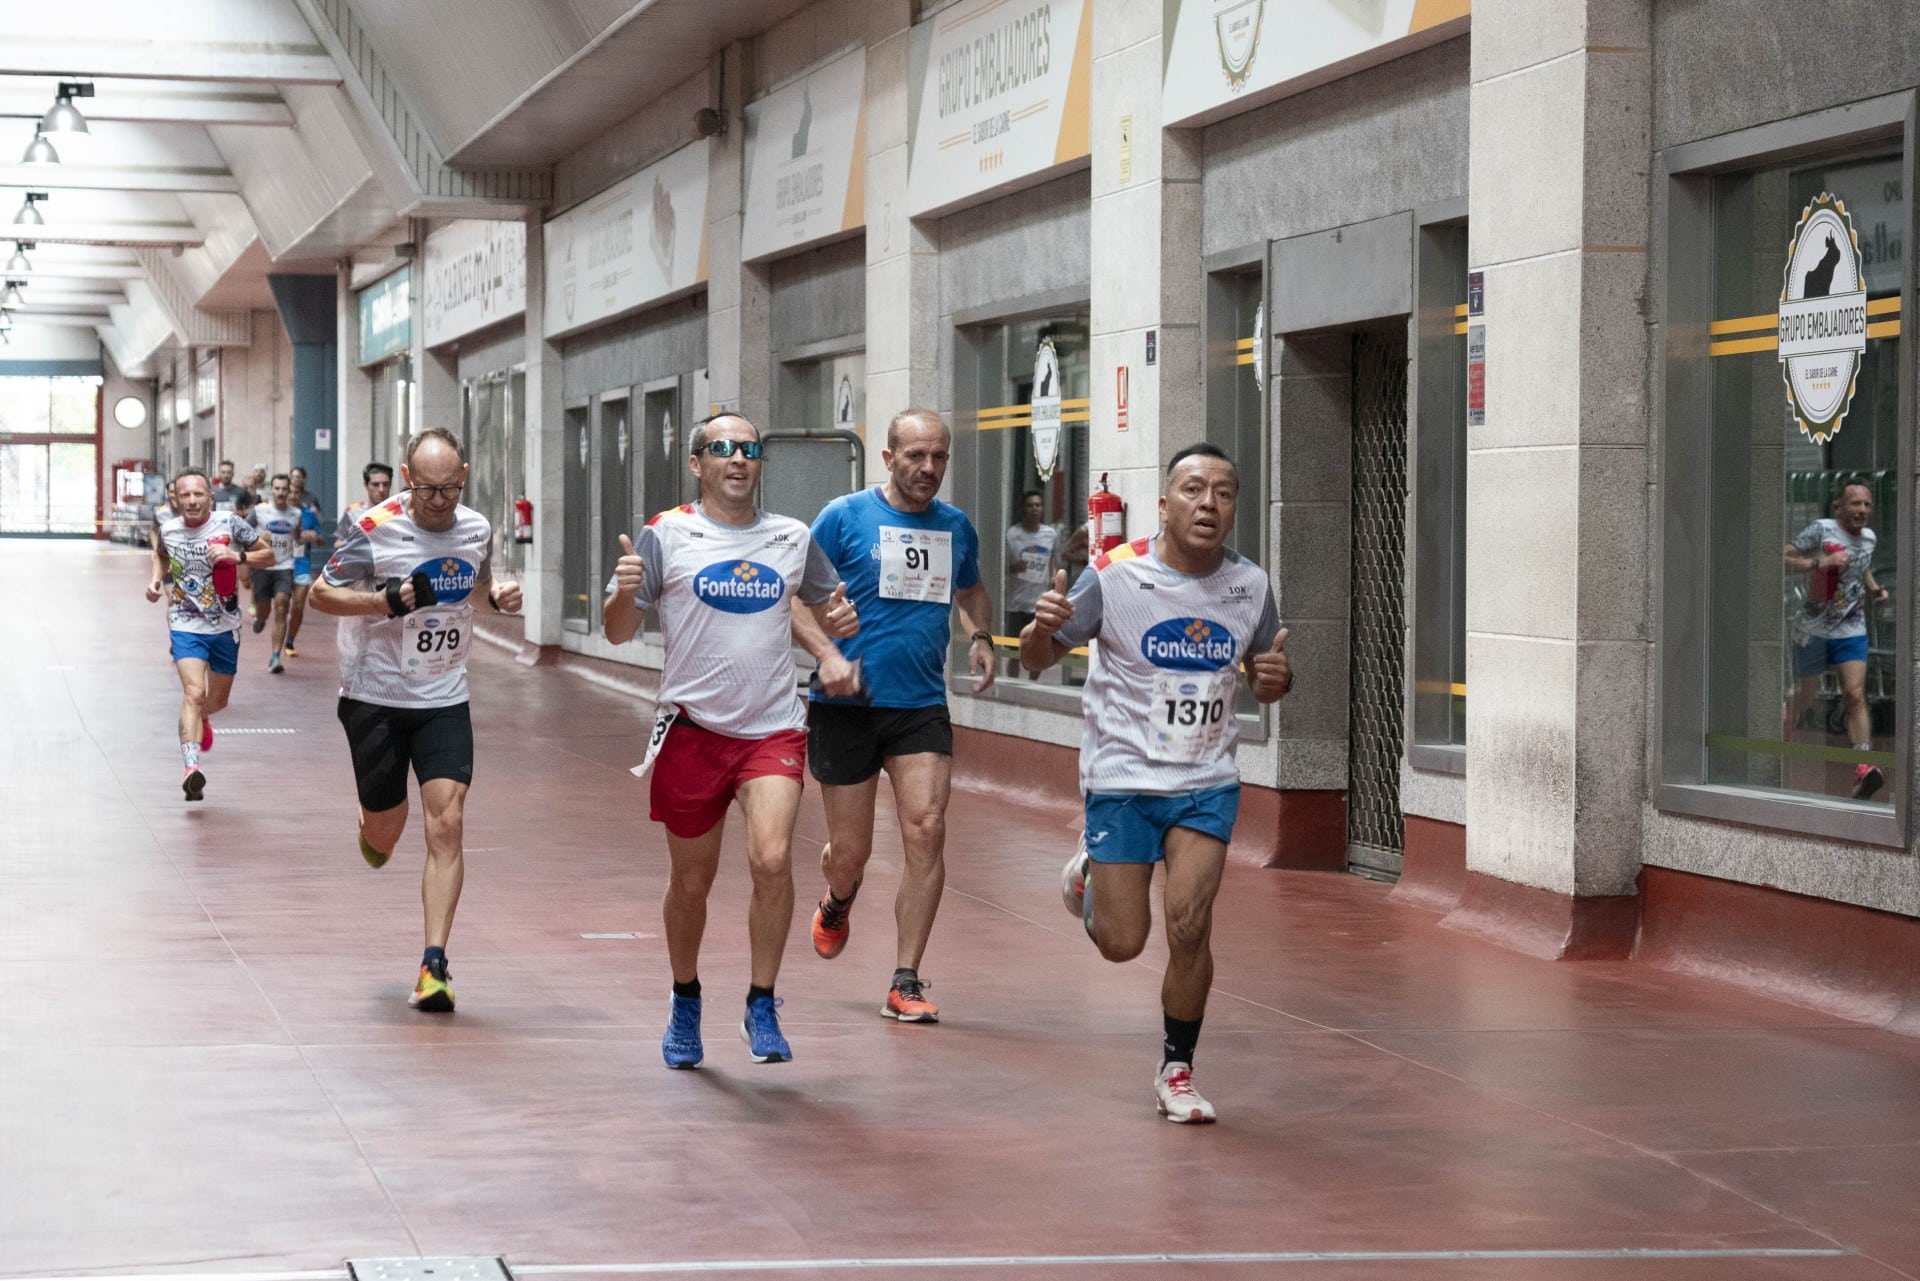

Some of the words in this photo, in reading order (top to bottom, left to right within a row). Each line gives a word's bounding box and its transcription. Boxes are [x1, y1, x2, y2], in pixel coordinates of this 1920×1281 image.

[939, 43, 971, 119] GRUPO
[974, 4, 1051, 105] EMBAJADORES
[1780, 313, 1806, 343] GRUPO
[1807, 306, 1865, 340] EMBAJADORES
[773, 534, 790, 542] 10K
[905, 547, 929, 571] 91
[430, 570, 475, 591] ntestad
[698, 576, 780, 599] Fontestad
[416, 628, 460, 653] 879
[1147, 636, 1232, 660] Fontestad
[1165, 698, 1224, 726] 1310
